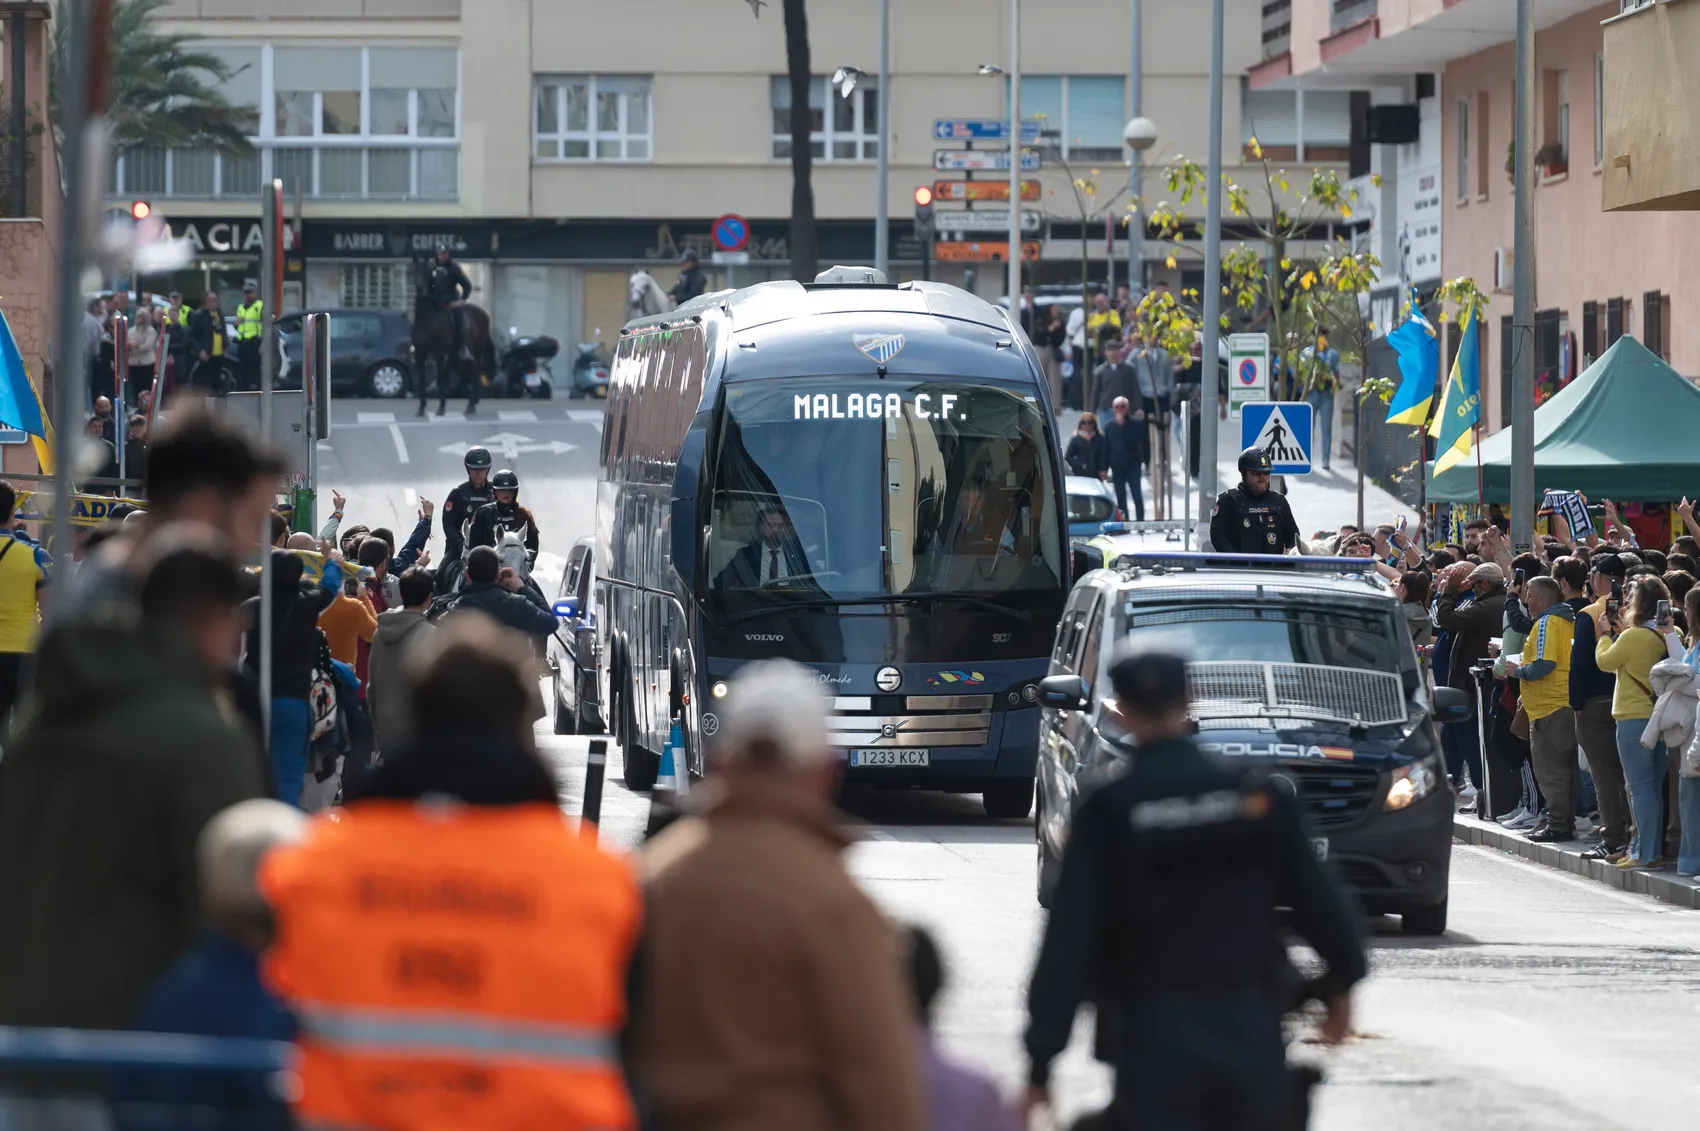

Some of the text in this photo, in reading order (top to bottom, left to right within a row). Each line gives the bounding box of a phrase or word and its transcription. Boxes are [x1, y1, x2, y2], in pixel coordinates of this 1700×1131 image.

[938, 212, 970, 222] Centro
[160, 223, 264, 251] ACIA
[794, 393, 966, 420] MALAGA C.F.
[745, 634, 784, 642] VOLVO
[992, 633, 1013, 643] SC7
[819, 673, 852, 685] Olmedo
[703, 718, 716, 730] 92
[1198, 743, 1327, 759] POLICIA
[862, 751, 925, 764] 1233 KCX
